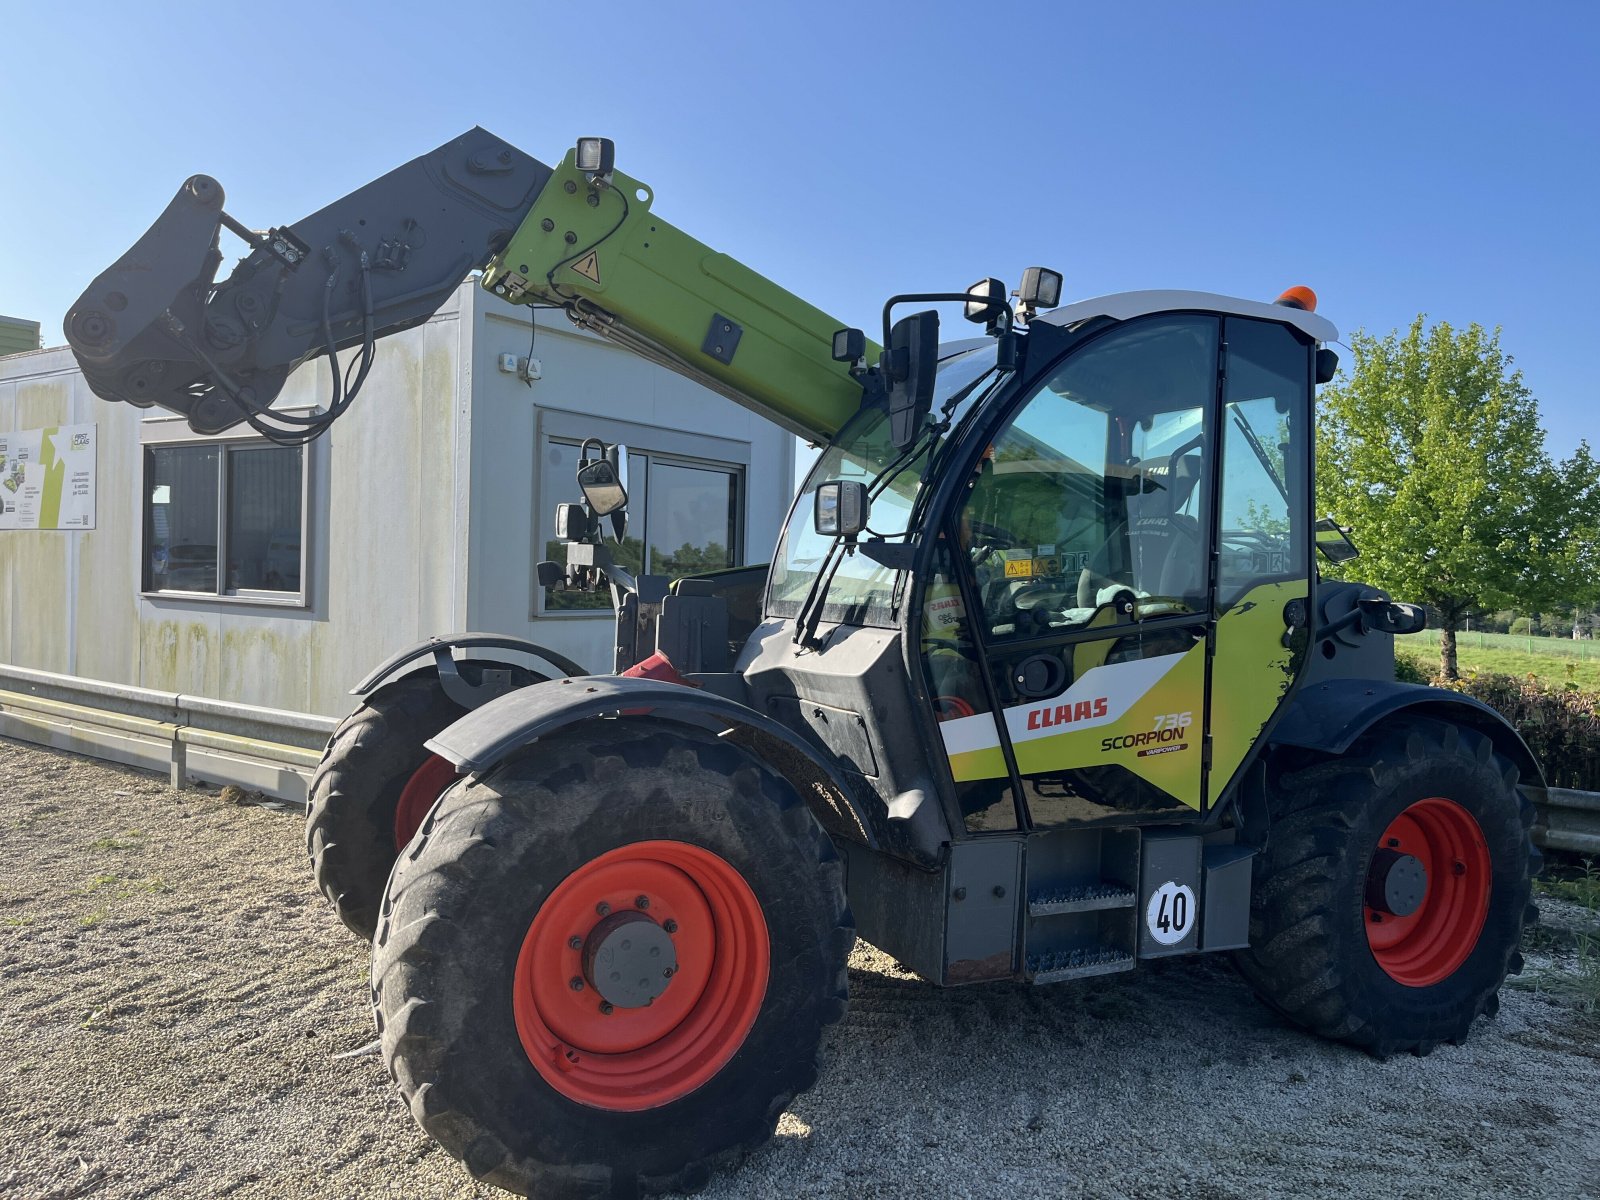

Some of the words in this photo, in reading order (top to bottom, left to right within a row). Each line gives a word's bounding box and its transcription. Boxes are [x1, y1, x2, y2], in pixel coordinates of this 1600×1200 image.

[1137, 518, 1168, 526] CLAAS
[1027, 697, 1108, 730] CLAAS
[1152, 711, 1192, 732] 736
[1101, 727, 1185, 752] SCORPION
[1146, 745, 1181, 756] VARIPOWER
[1157, 892, 1187, 933] 40
